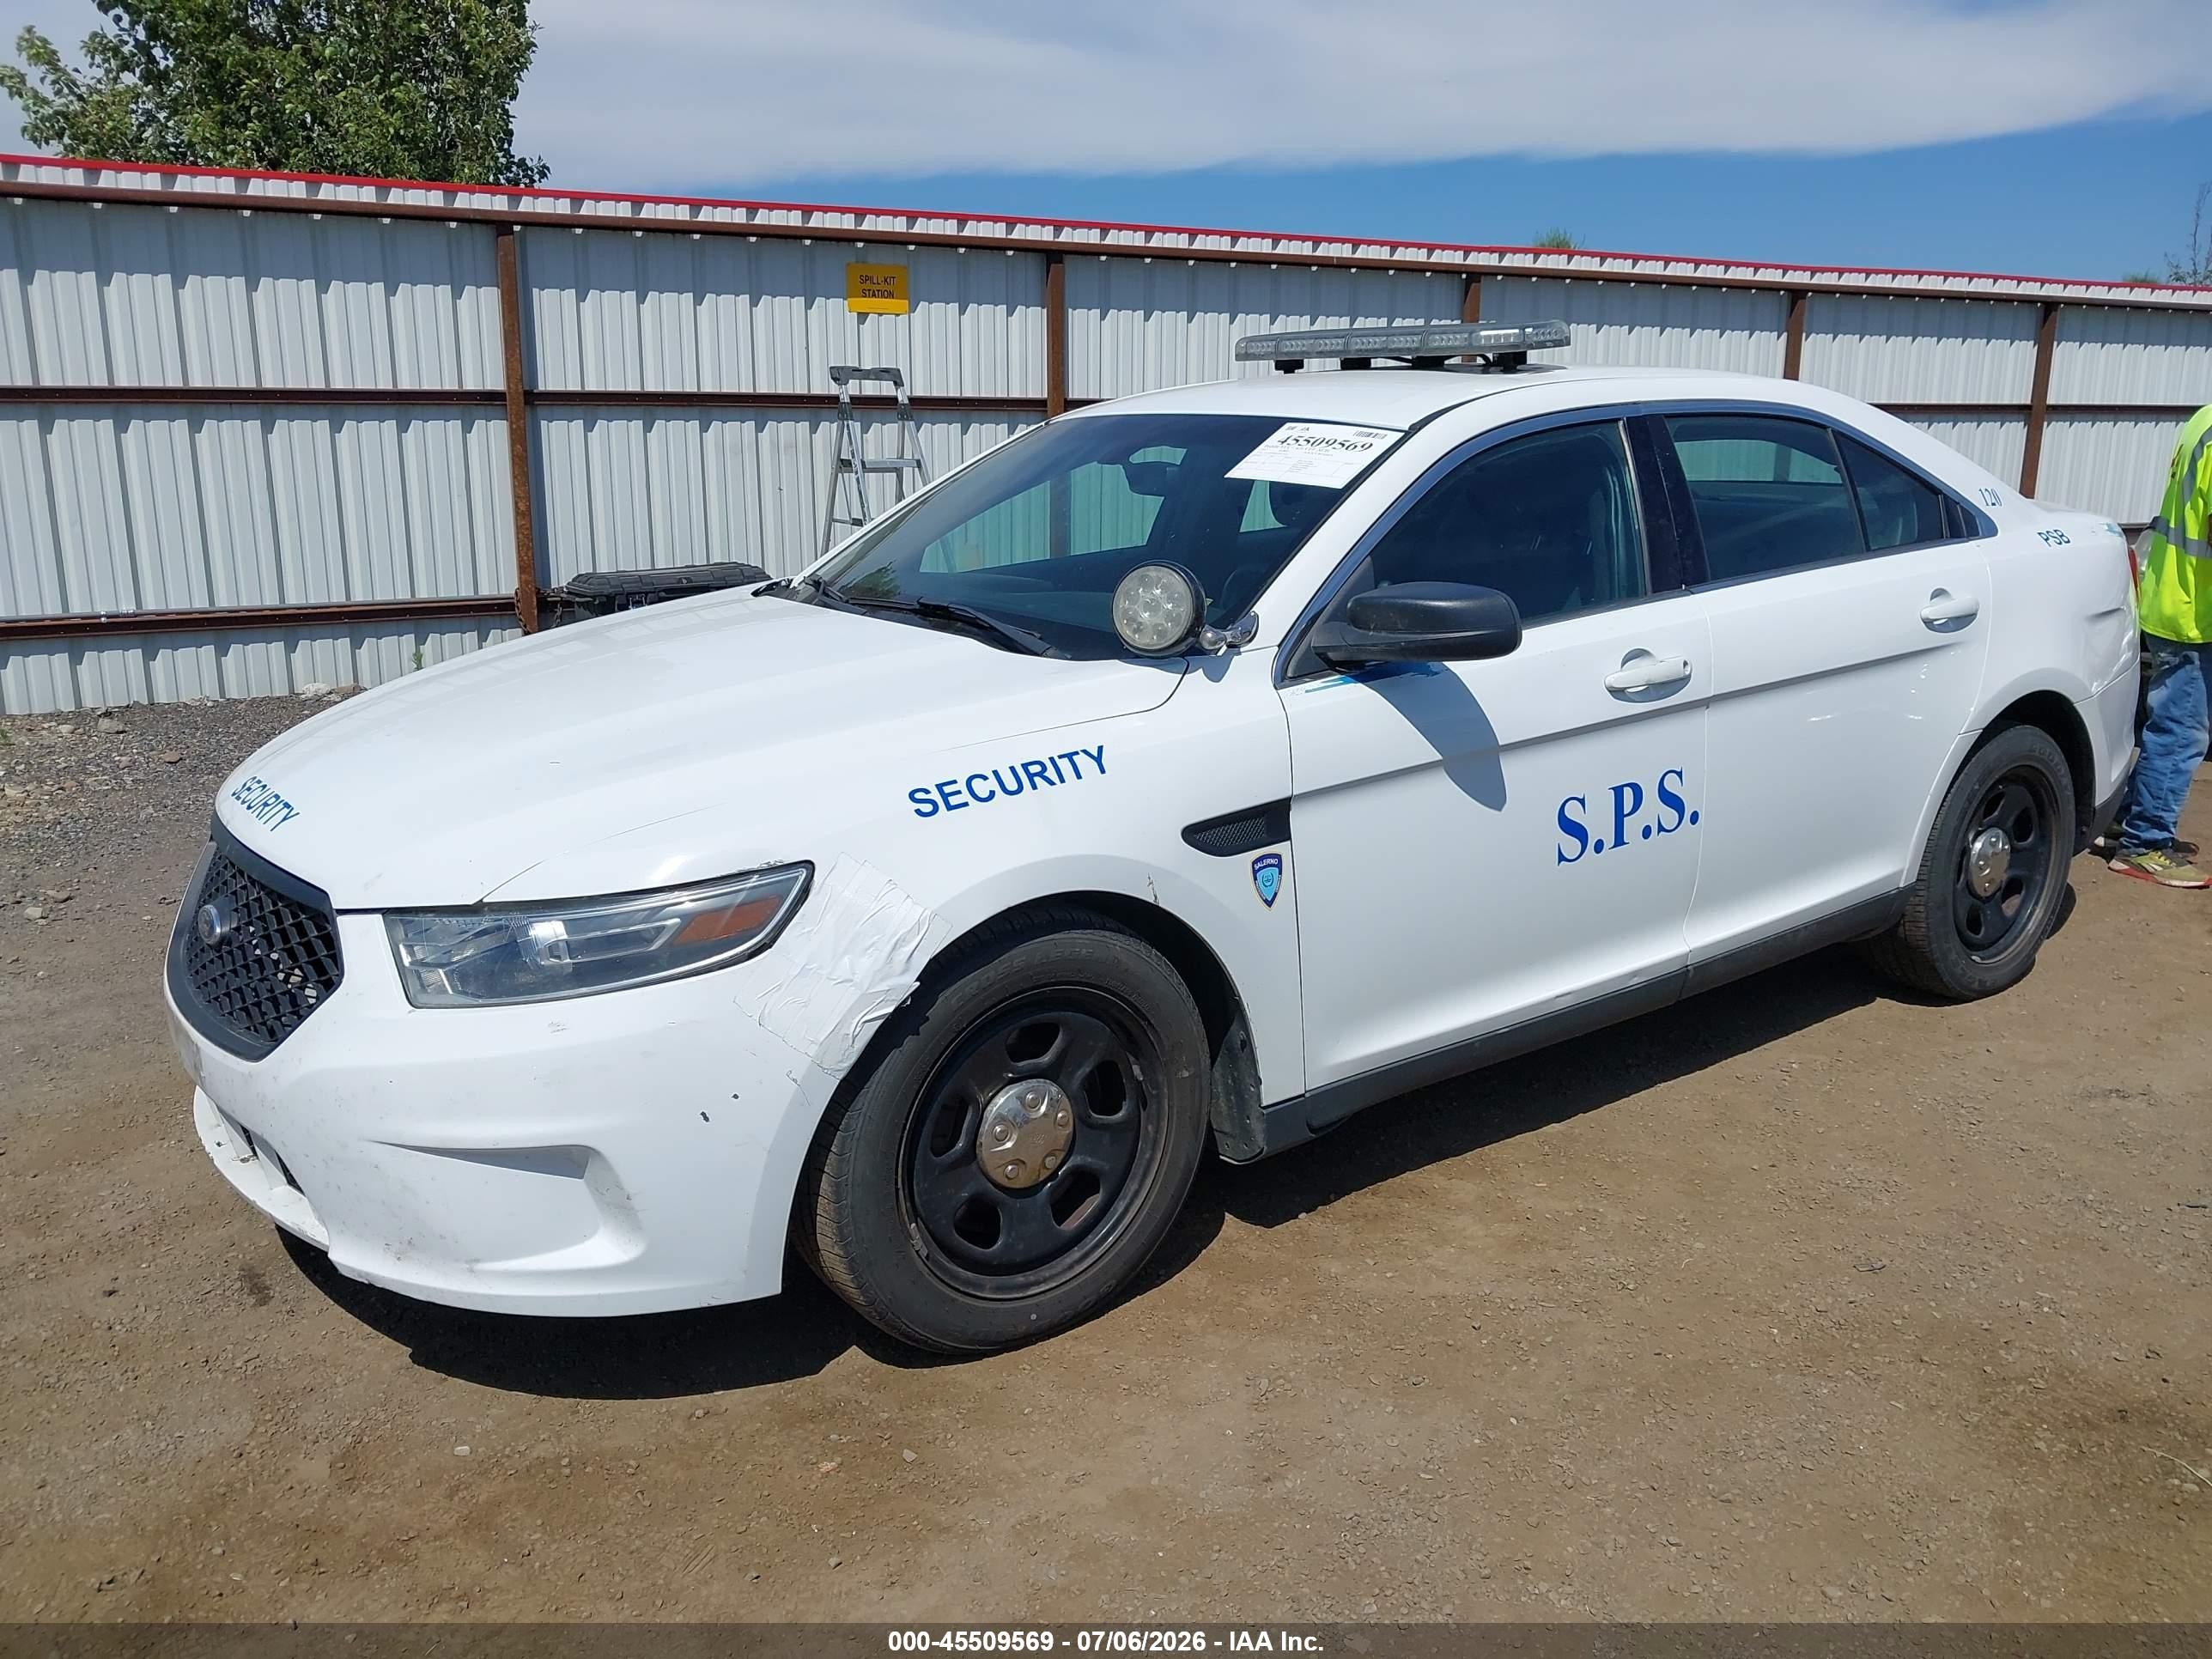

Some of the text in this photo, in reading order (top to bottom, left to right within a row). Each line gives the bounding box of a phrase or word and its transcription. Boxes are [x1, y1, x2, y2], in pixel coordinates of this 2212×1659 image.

[859, 274, 896, 286] SPILL-KIT
[861, 288, 895, 299] STATION
[1277, 434, 1374, 453] 45509569
[1978, 488, 2002, 507] 120
[2037, 529, 2071, 547] PSB
[908, 744, 1107, 818] SECURITY
[230, 775, 301, 832] SECURITY
[1557, 767, 1699, 866] S.P.S.
[1254, 858, 1279, 871] SALERNO
